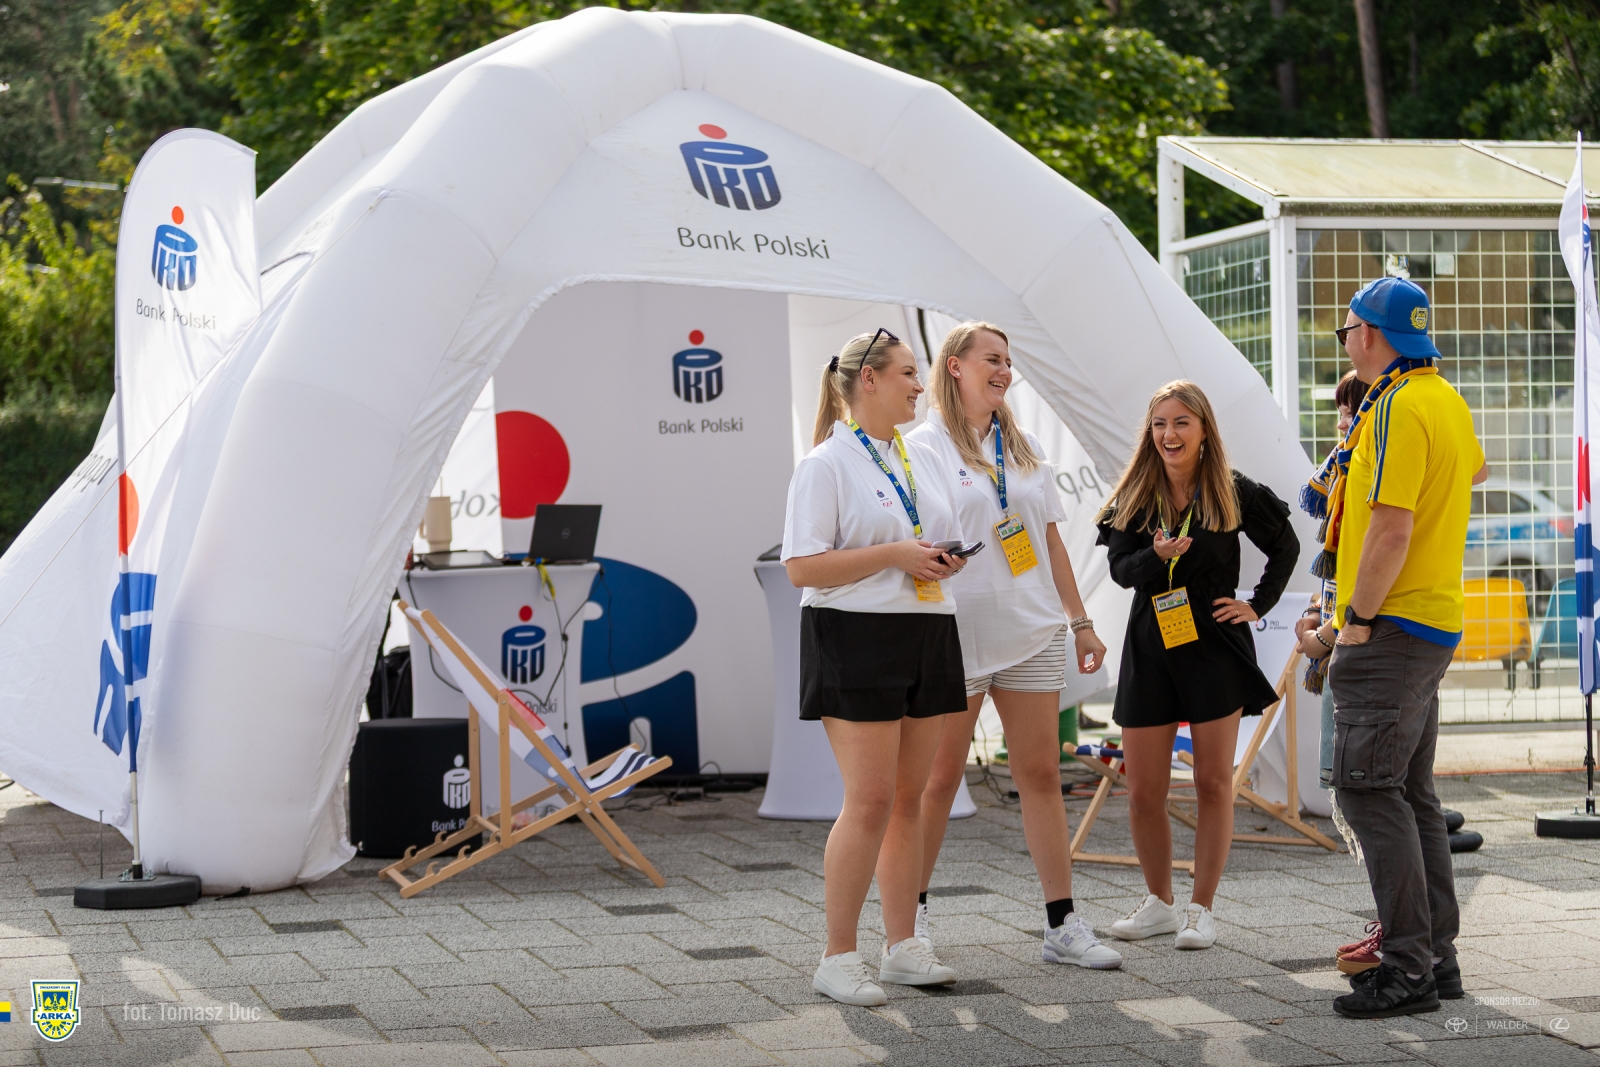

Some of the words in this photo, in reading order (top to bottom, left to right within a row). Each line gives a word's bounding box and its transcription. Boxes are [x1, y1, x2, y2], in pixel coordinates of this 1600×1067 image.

[679, 141, 782, 211] PKO
[151, 224, 198, 291] PKO
[677, 226, 746, 252] Bank
[754, 233, 830, 259] Polski
[136, 298, 166, 322] Bank
[172, 307, 216, 330] Polski
[672, 348, 723, 404] PKO
[658, 419, 696, 435] Bank
[701, 417, 744, 433] Polski
[502, 625, 546, 684] PKO
[431, 820, 457, 832] Bank
